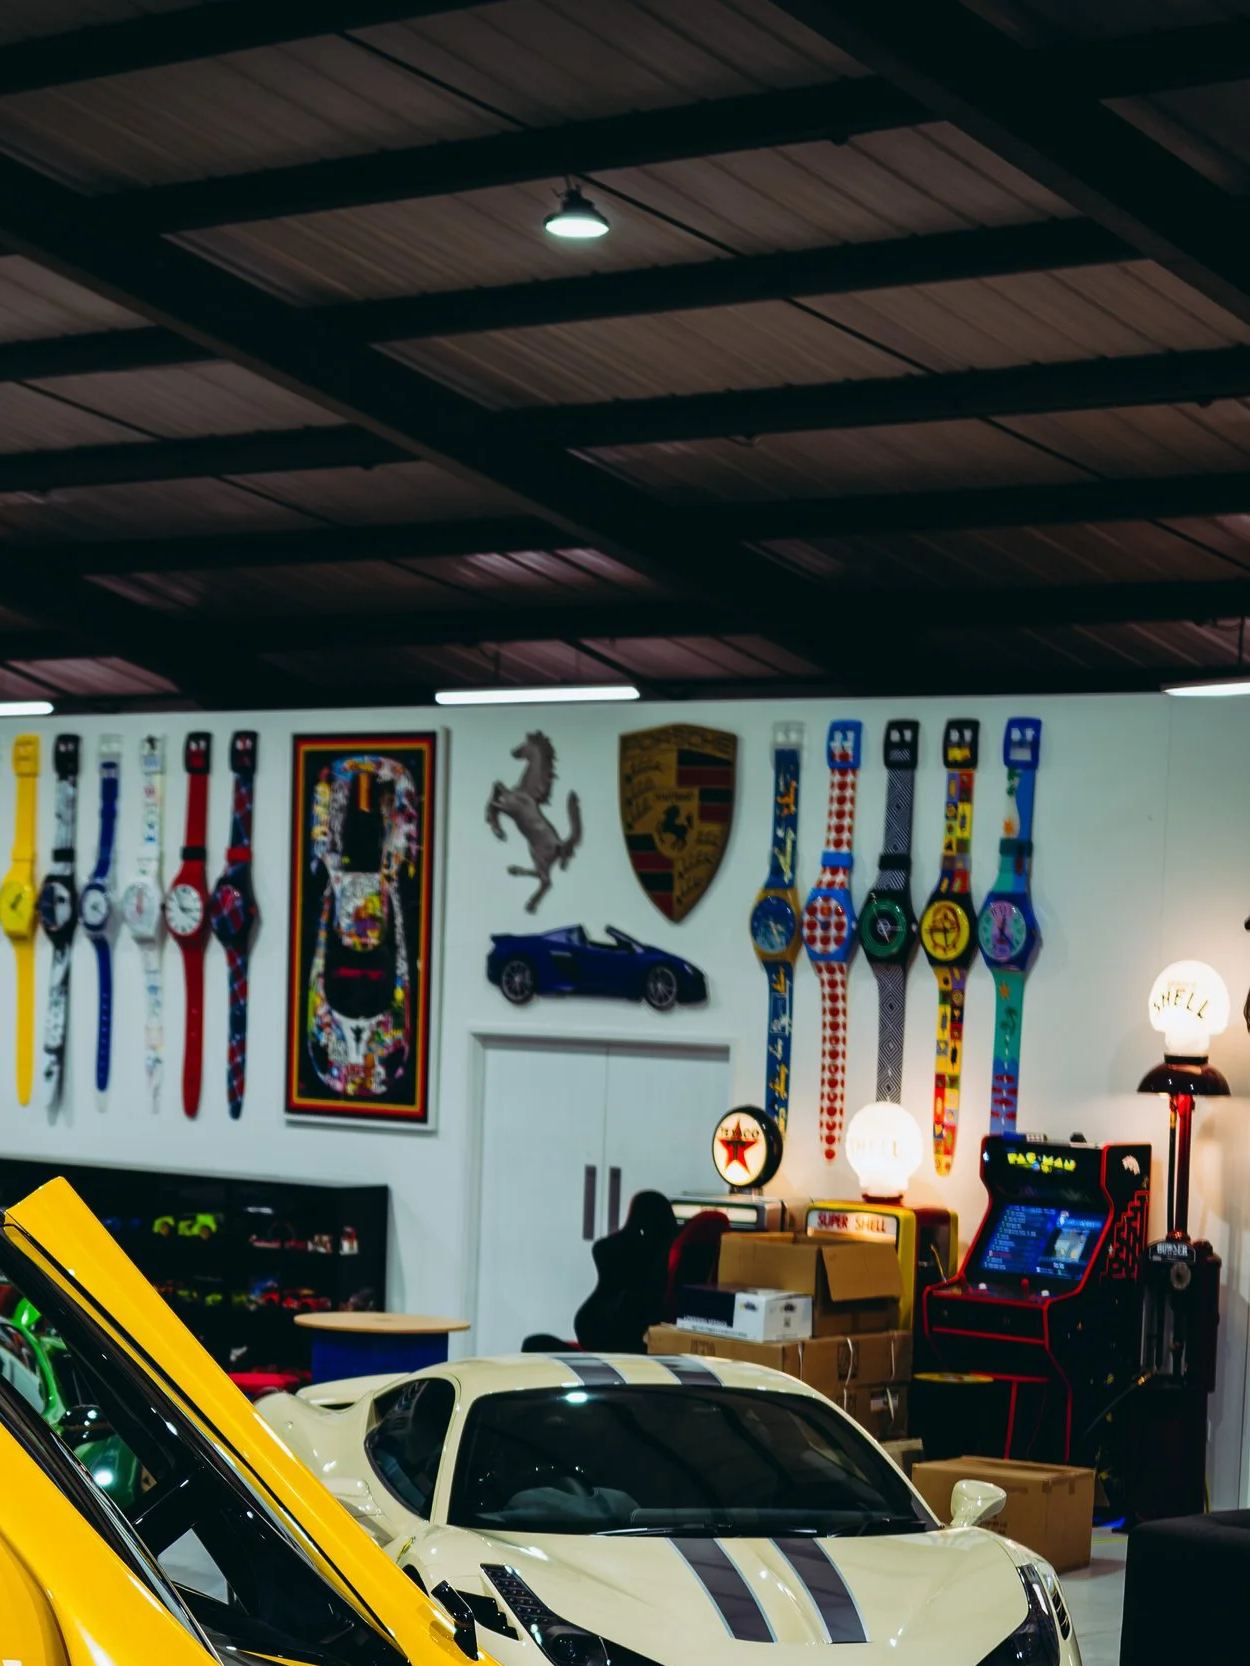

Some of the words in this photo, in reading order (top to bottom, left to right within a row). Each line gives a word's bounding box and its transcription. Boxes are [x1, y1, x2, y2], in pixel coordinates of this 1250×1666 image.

[1153, 988, 1208, 1019] SHELL
[720, 1127, 760, 1140] TEXACO
[817, 1212, 849, 1229] SUPER
[855, 1216, 885, 1232] SHELL
